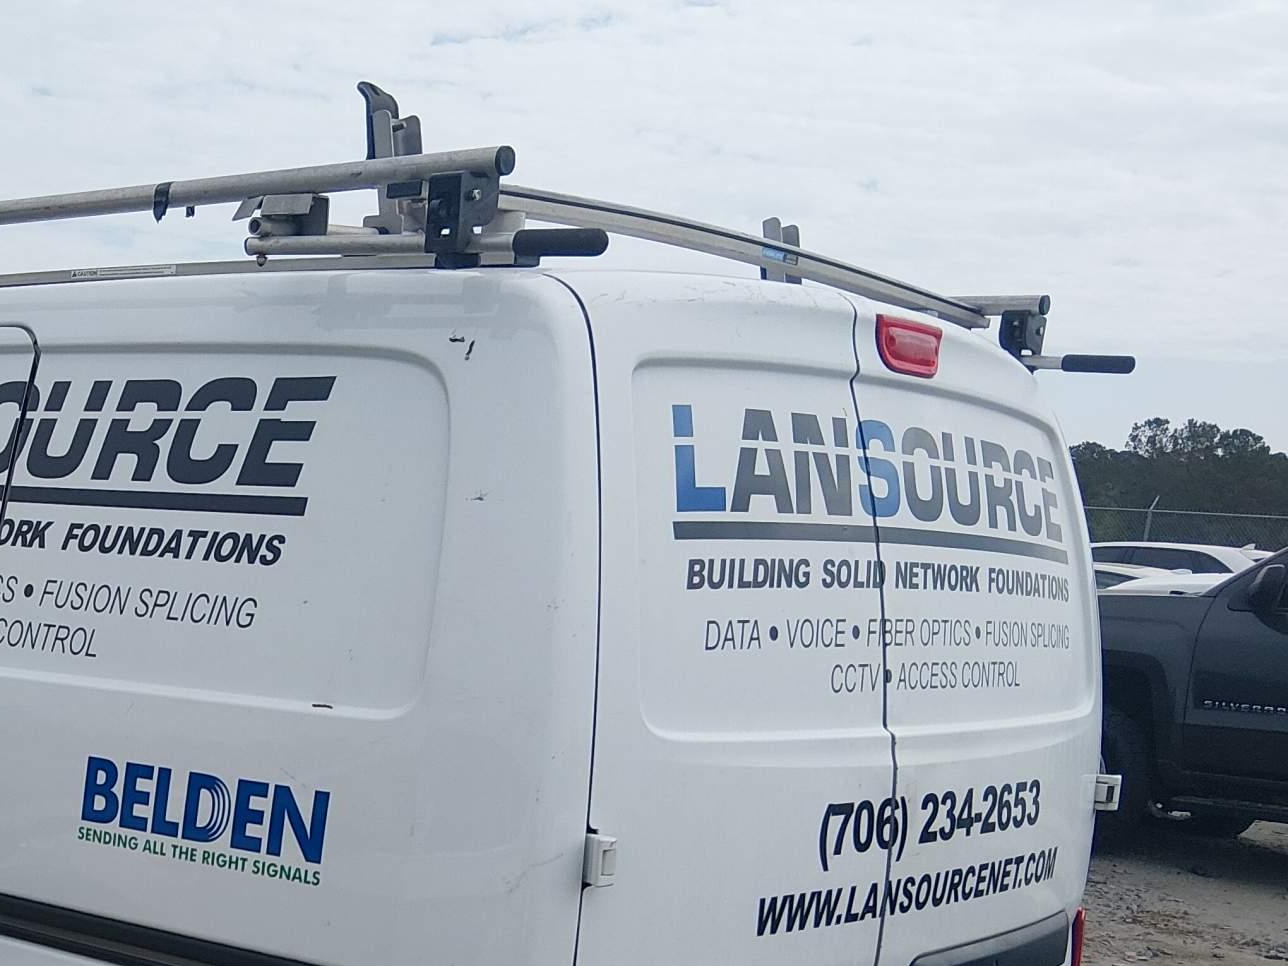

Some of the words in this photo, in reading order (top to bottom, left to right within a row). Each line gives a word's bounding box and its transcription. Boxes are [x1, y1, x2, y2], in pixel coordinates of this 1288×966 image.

[671, 404, 1063, 543] LANSOURCE
[60, 523, 286, 566] FOUNDATIONS
[40, 579, 133, 616] FUSION
[133, 588, 258, 629] SPLICING
[686, 557, 811, 590] BUILDING
[821, 558, 887, 589] SOLID
[895, 561, 980, 593] NETWORK
[988, 566, 1070, 604] FOUNDATIONS
[704, 620, 761, 651] DATA
[786, 618, 847, 649] VOICE
[866, 618, 915, 648] FIBER
[920, 618, 971, 648] OPTICS
[985, 620, 1028, 648] FUSION
[1030, 622, 1070, 650] SPLICING
[831, 664, 881, 693] CCTV
[897, 661, 958, 690] ACCESS
[961, 660, 1020, 688] CONTROL
[81, 755, 331, 864] BELDEN
[819, 796, 908, 872] (706)
[918, 779, 1041, 845] 234-2653
[77, 826, 139, 850] SENDING
[142, 838, 167, 857] ALL
[171, 844, 198, 862] THE
[201, 851, 248, 873] RIGHT
[251, 859, 321, 886] SIGNALS
[756, 846, 1059, 937] WWW.LANSOURCENET.COM
